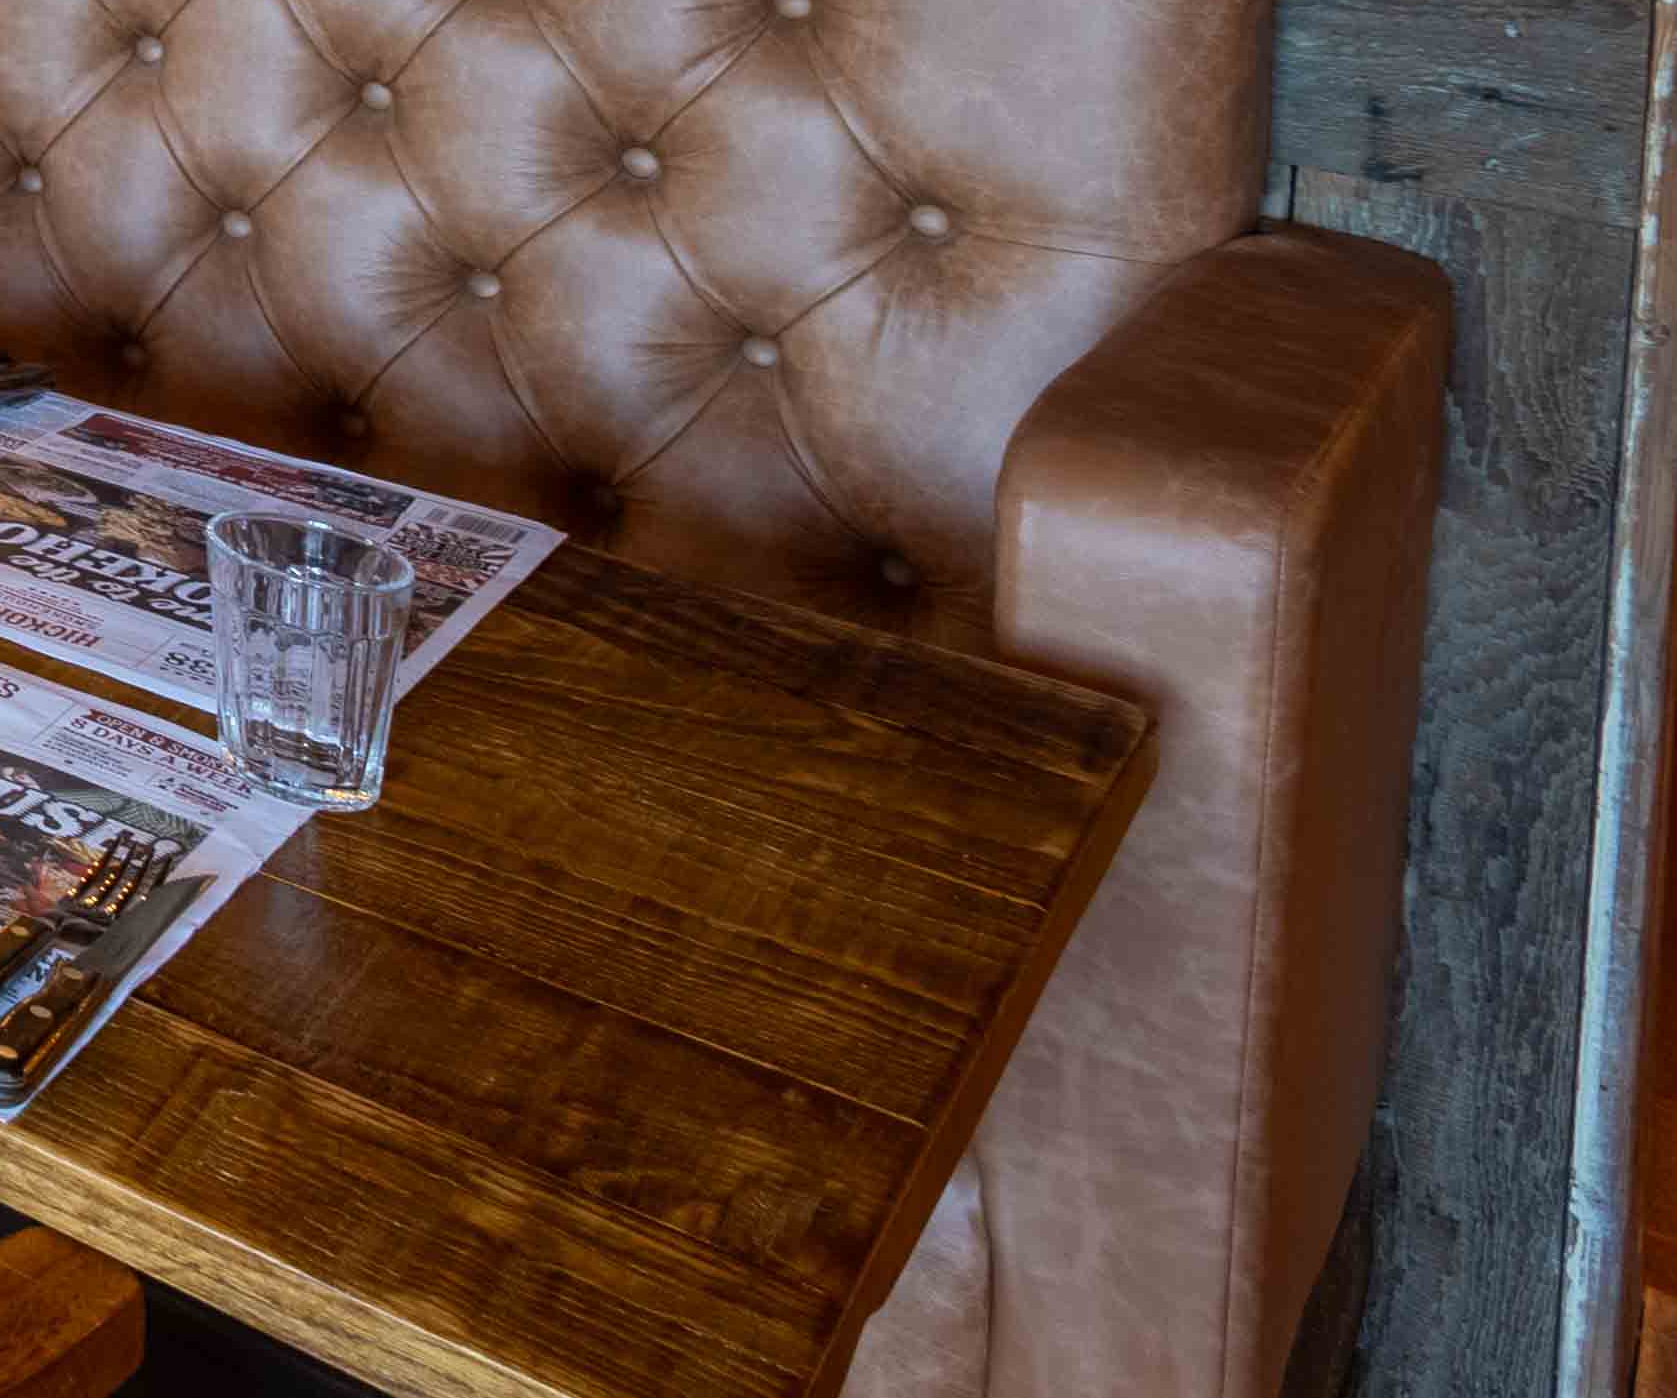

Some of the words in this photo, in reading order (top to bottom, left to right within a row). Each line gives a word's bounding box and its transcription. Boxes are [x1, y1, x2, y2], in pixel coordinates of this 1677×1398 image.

[70, 717, 88, 732] 8
[90, 724, 153, 757] DAYS
[158, 755, 177, 768] A
[182, 760, 252, 800] WEEK
[97, 713, 147, 740] OPEN
[147, 732, 167, 749] &
